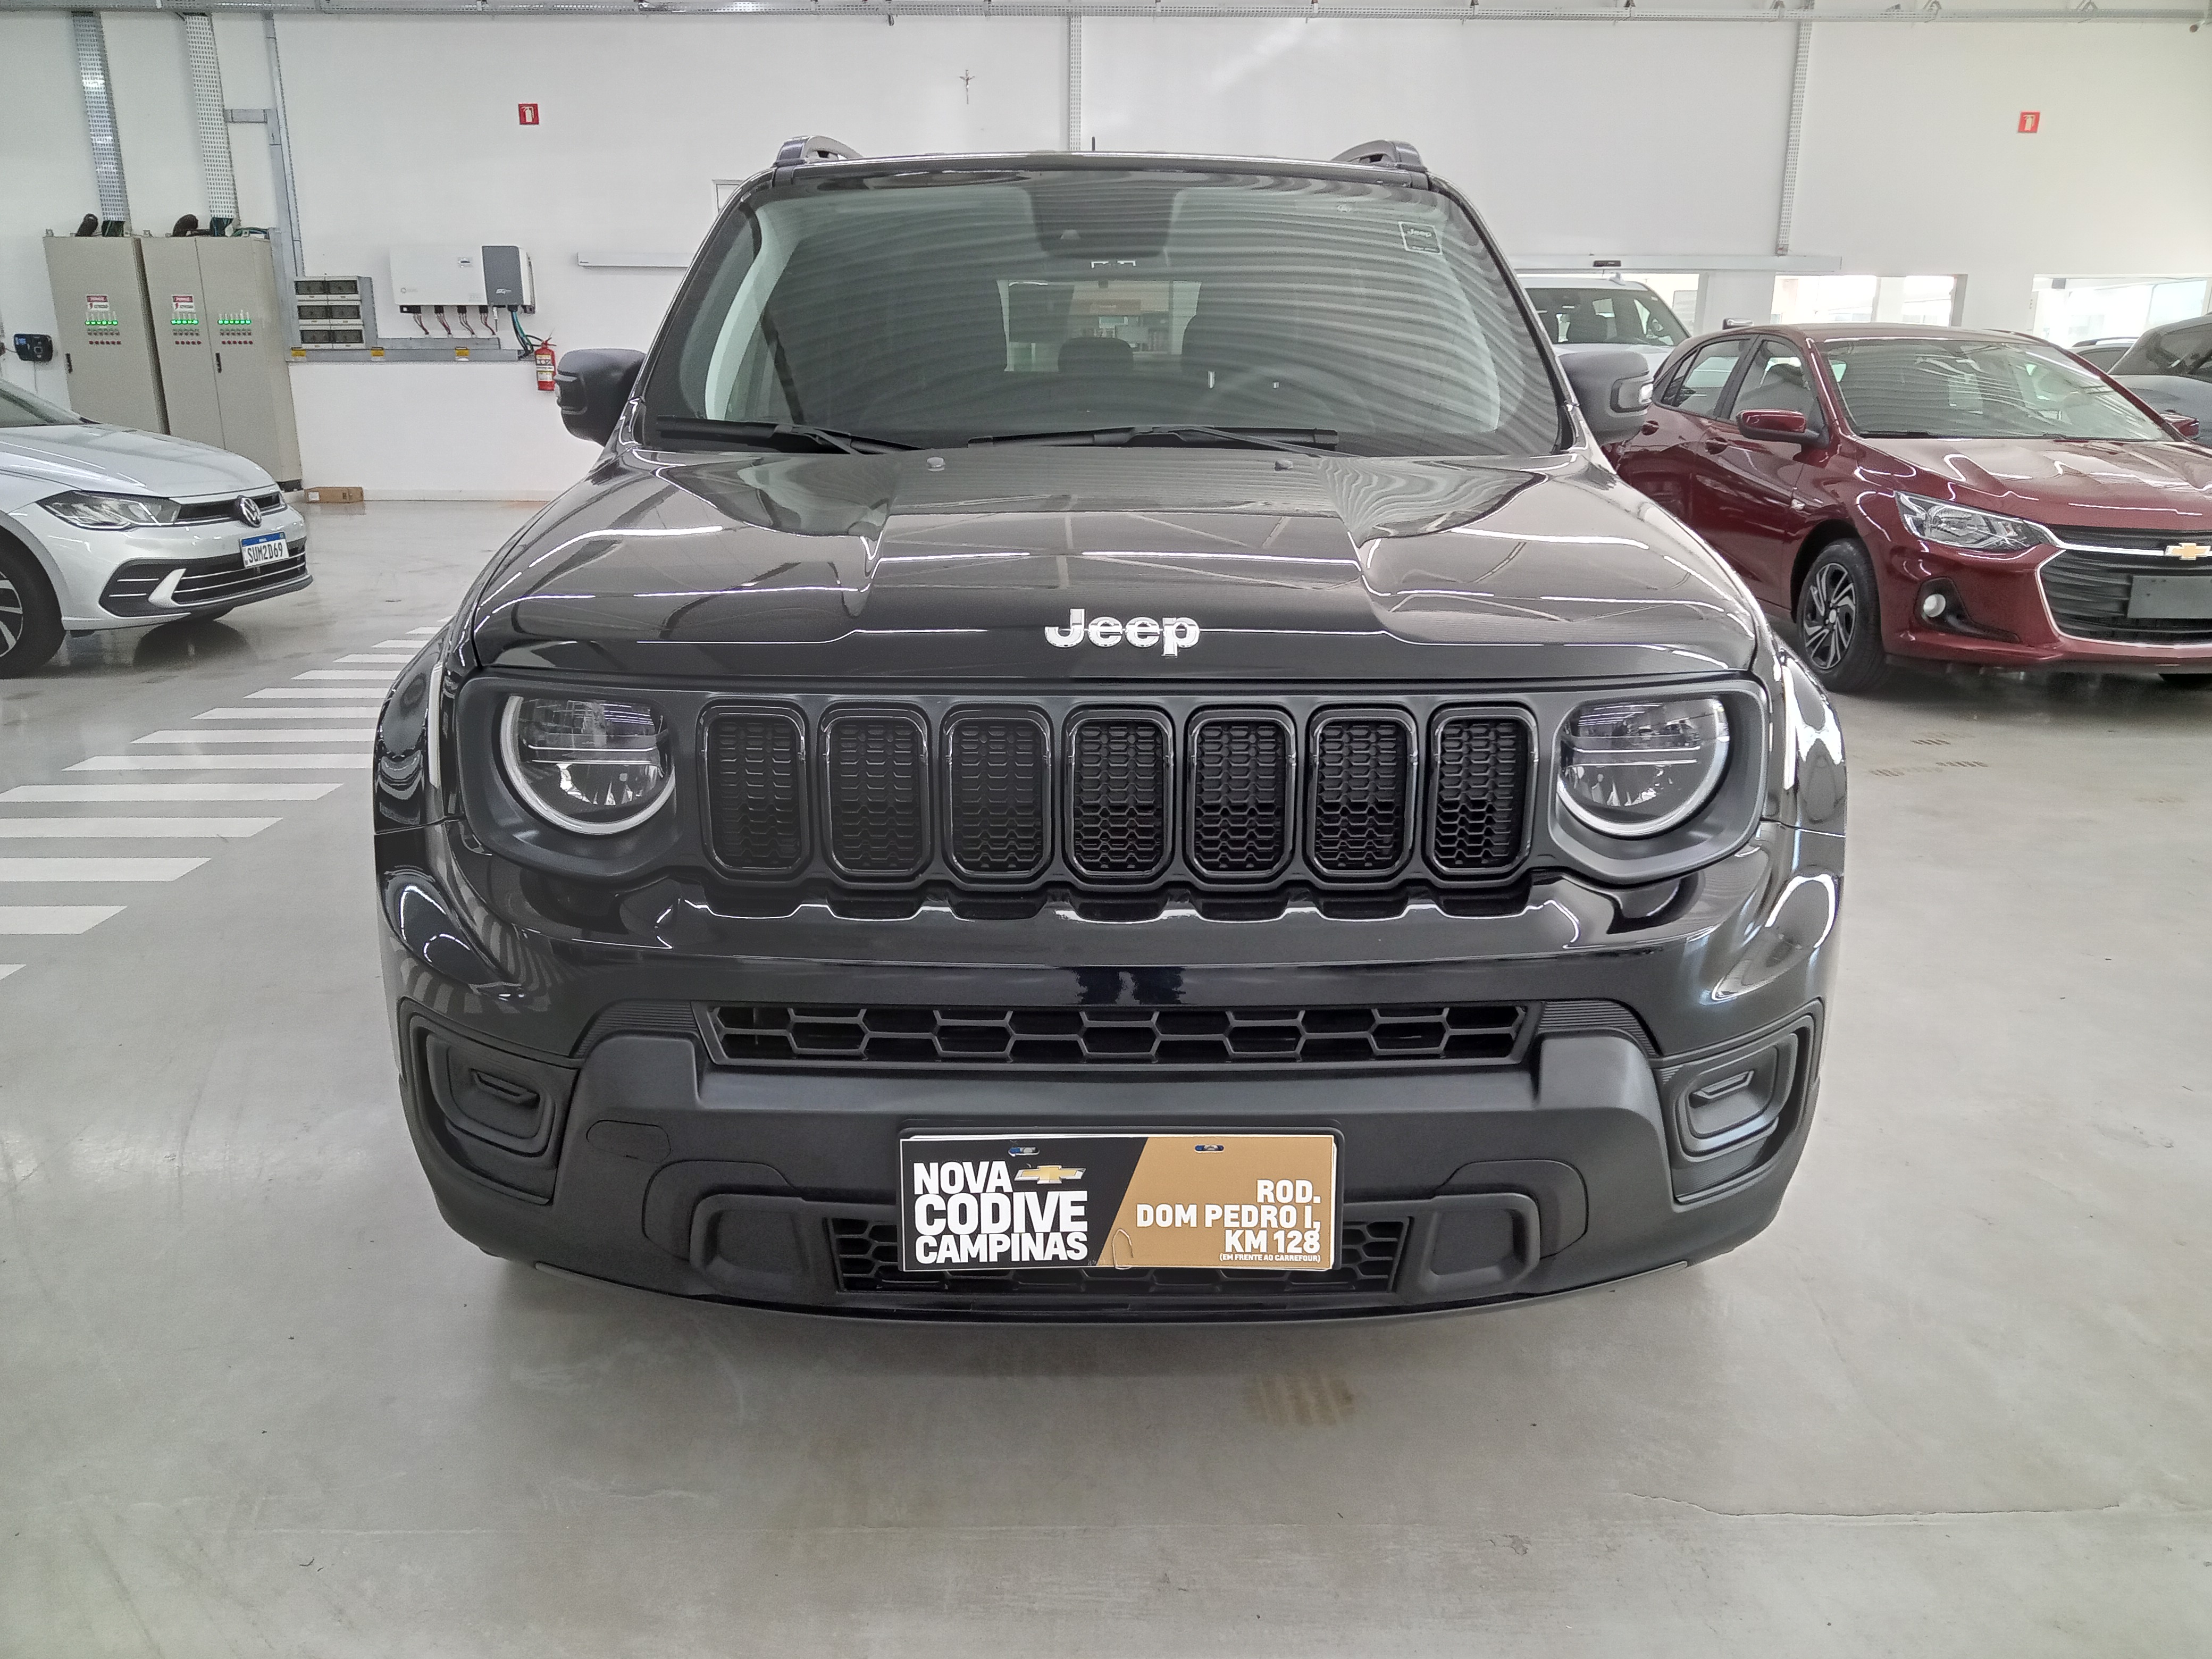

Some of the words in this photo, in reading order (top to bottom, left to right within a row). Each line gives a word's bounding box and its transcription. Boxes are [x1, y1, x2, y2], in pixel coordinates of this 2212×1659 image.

[247, 542, 283, 563] SUM2D69
[1044, 608, 1200, 656] Jeep
[914, 1161, 1013, 1195] NOVA
[1256, 1179, 1321, 1203] ROD.
[915, 1191, 1088, 1236] CODIVE
[1136, 1204, 1197, 1227] DOM
[1204, 1204, 1297, 1228] PEDRO
[1304, 1205, 1321, 1231] I,
[916, 1231, 1088, 1264] CAMPINAS
[1225, 1229, 1267, 1253] KM
[1272, 1230, 1321, 1253] 128
[1275, 1254, 1321, 1263] CARREFOUR)
